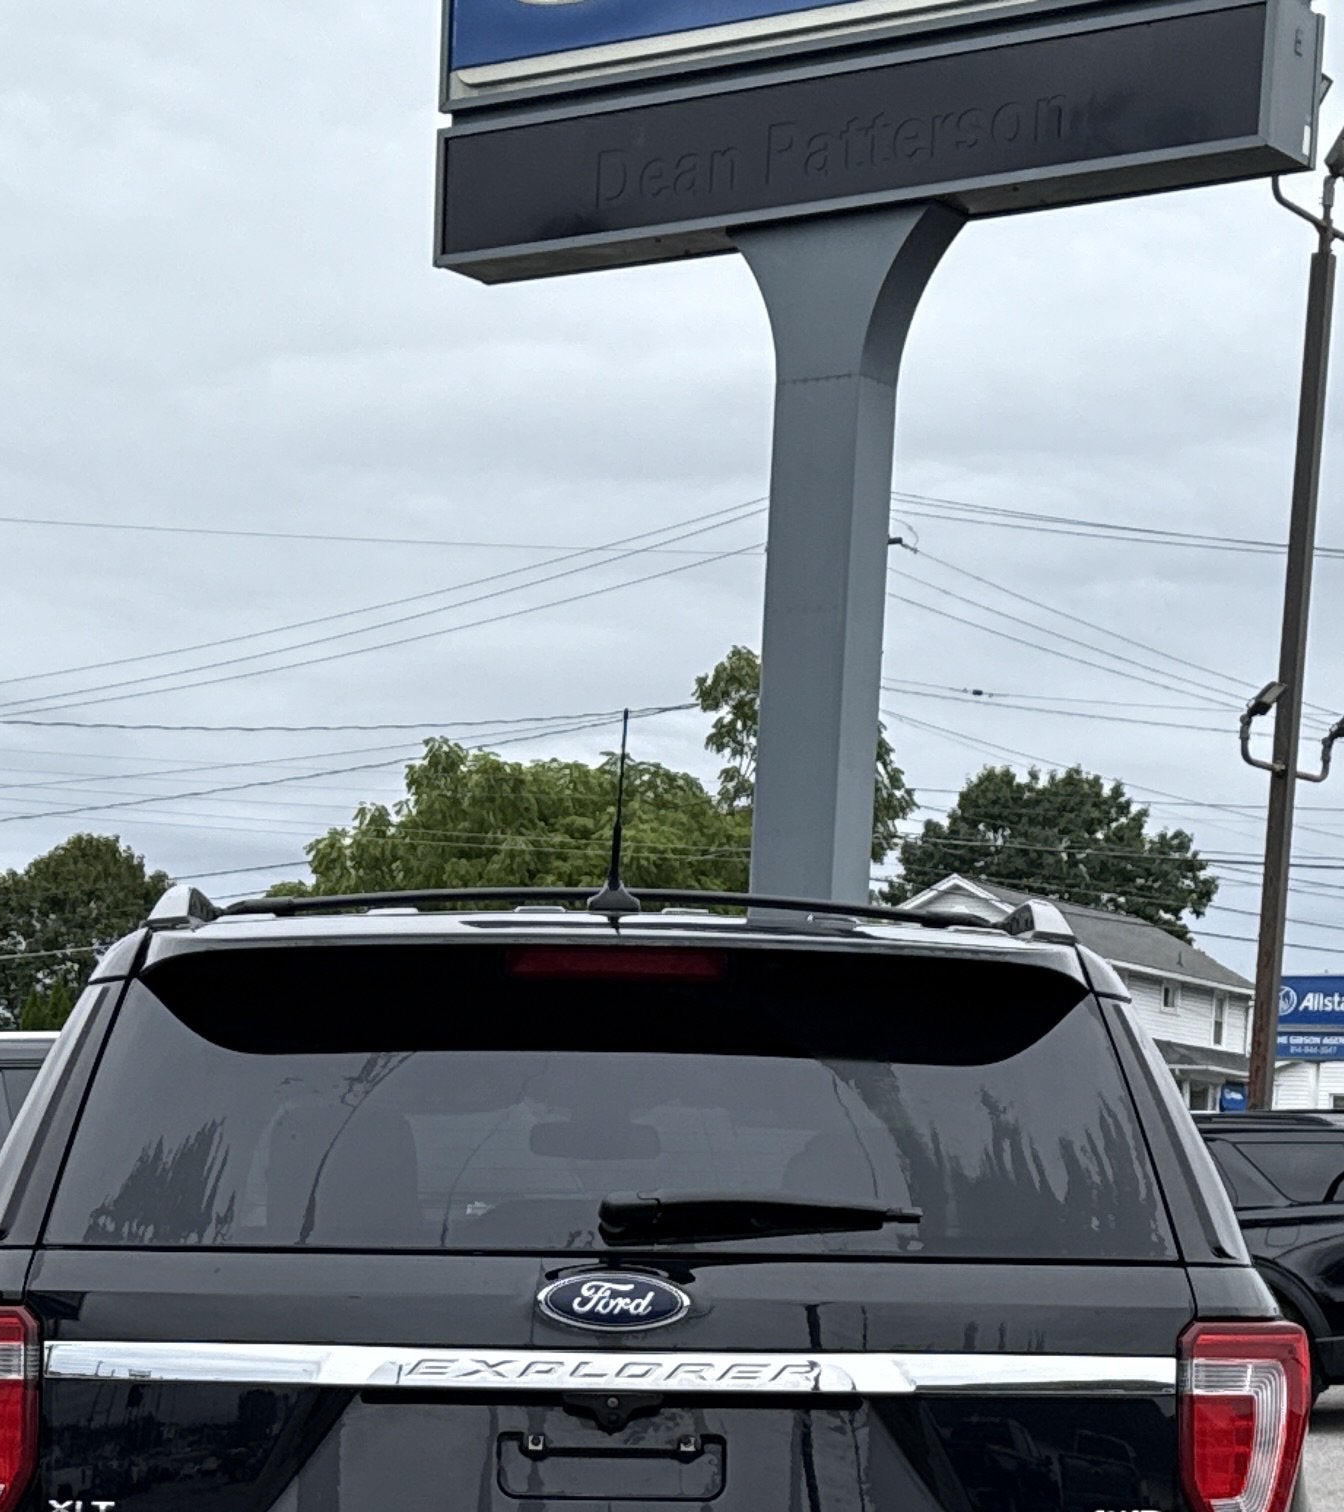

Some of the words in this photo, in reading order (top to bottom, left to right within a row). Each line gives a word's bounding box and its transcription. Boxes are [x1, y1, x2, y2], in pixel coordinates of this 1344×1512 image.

[594, 145, 740, 209] Dean
[763, 93, 1067, 186] Patterson
[572, 1281, 655, 1315] Ford
[405, 1358, 819, 1383] EXPLORER
